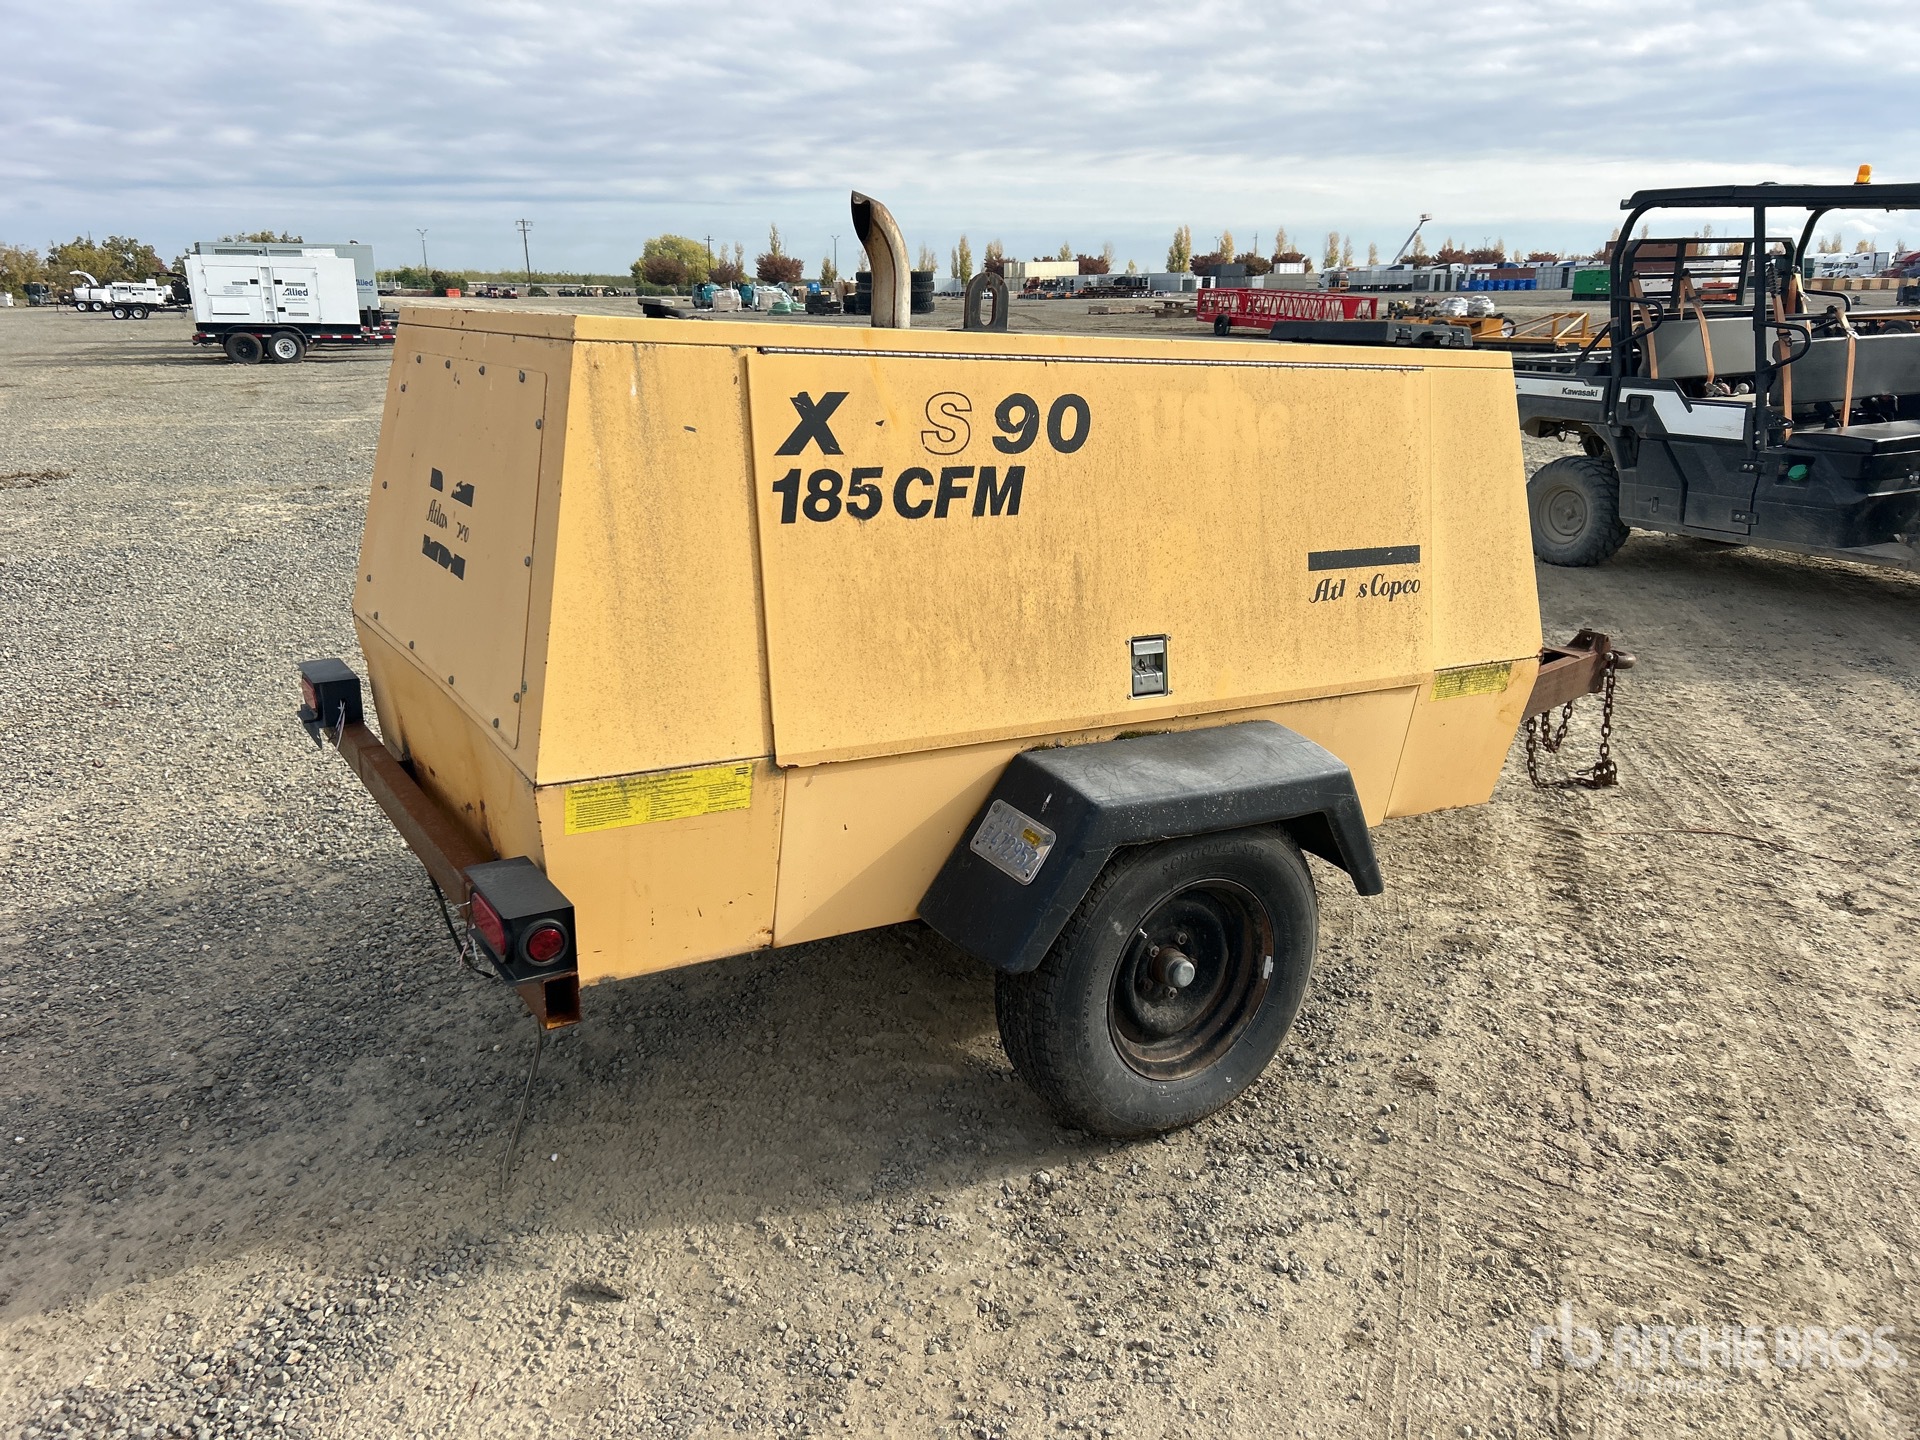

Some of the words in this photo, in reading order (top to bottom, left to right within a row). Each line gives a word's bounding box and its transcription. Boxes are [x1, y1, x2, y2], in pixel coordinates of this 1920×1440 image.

[282, 287, 309, 297] Allied
[1561, 387, 1598, 397] Kawasaki
[991, 392, 1092, 455] 90
[771, 466, 884, 525] 185
[892, 465, 1026, 520] CFM
[1370, 573, 1421, 602] Copco
